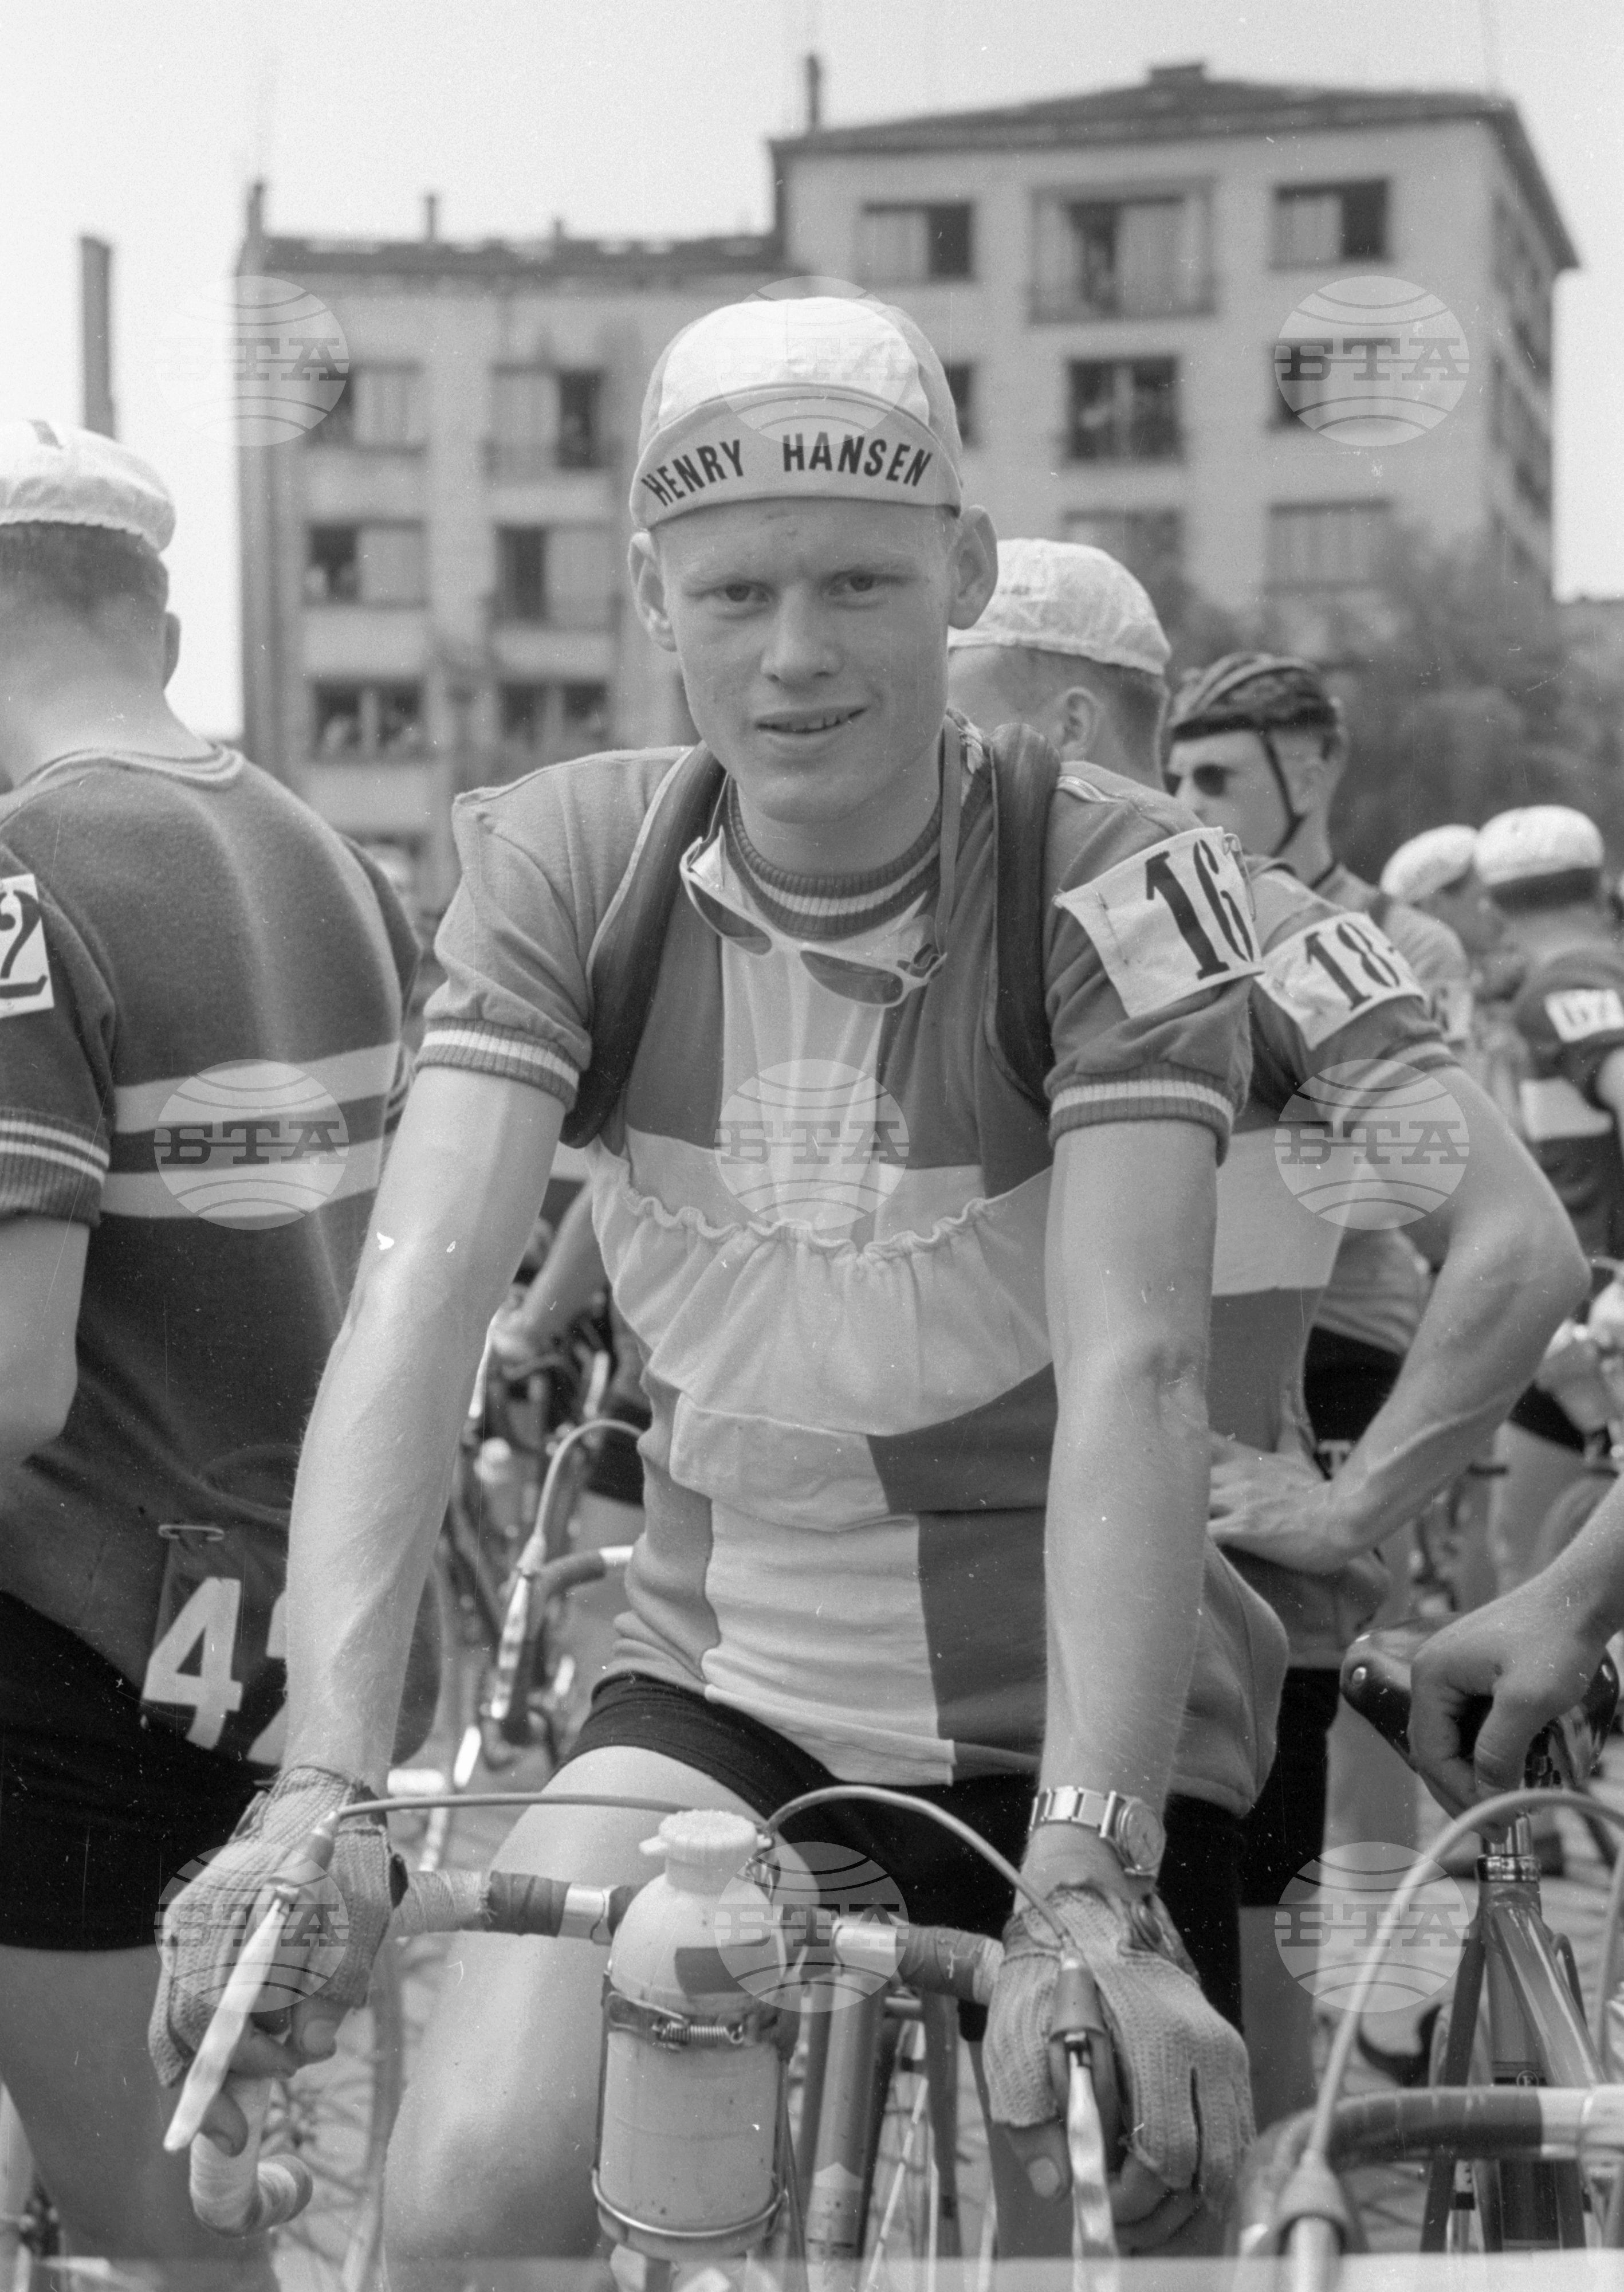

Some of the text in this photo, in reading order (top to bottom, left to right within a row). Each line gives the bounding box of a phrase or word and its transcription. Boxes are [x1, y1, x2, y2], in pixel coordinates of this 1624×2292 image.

[640, 431, 933, 507] HENRY HANSEN
[1304, 921, 1400, 1011] 18
